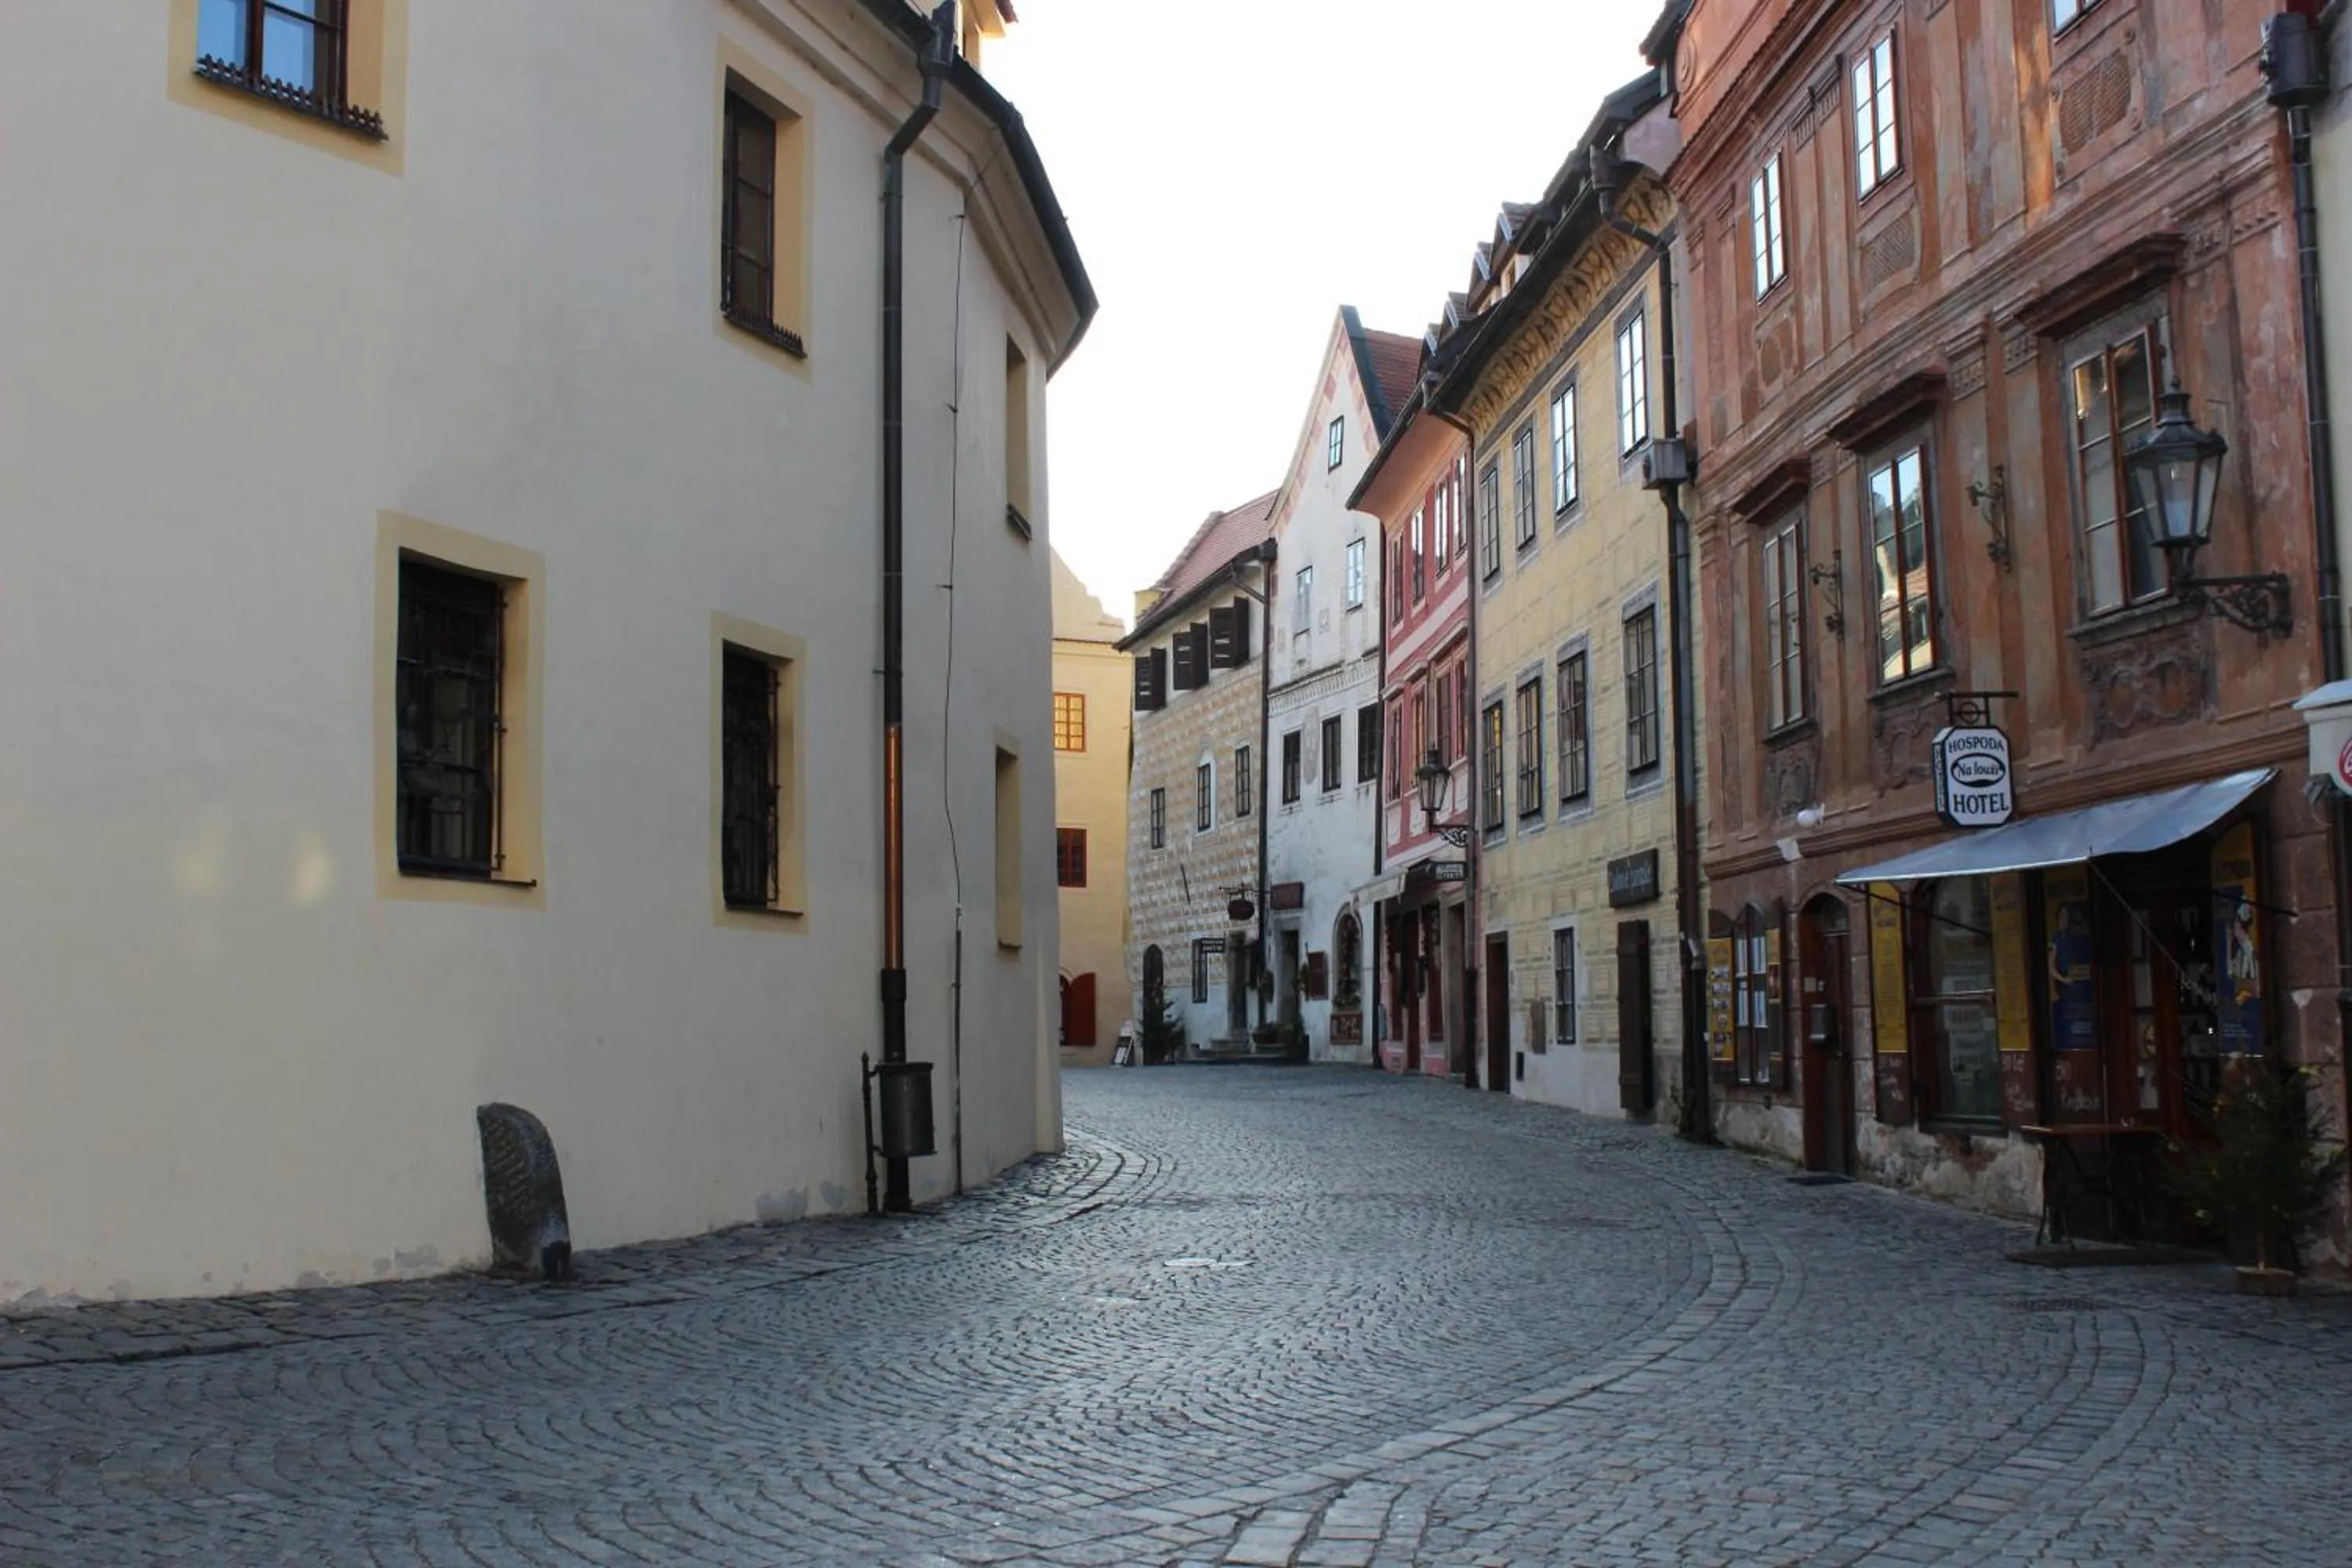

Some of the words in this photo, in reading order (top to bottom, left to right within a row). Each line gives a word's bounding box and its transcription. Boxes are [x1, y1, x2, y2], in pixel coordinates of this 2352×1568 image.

[1948, 736, 2005, 753] HOSPODA
[1957, 761, 1972, 777] Na
[1953, 793, 2009, 814] HOTEL
